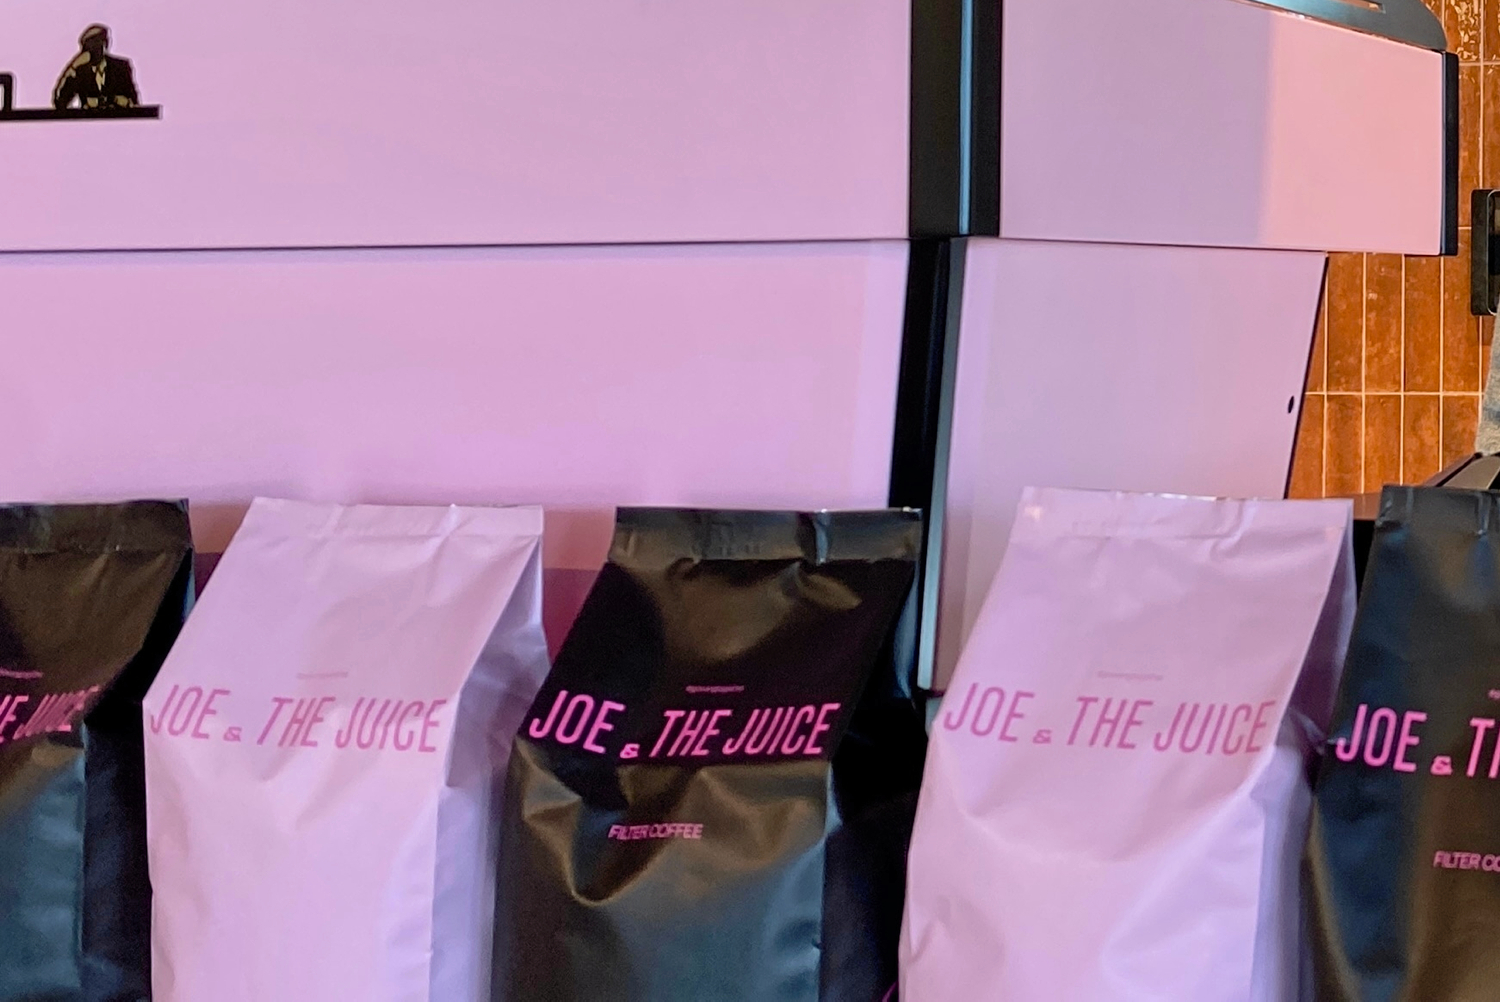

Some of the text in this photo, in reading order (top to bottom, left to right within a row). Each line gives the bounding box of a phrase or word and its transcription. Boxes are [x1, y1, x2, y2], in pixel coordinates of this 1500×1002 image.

[150, 684, 448, 754] JOE & THE JUICE
[528, 690, 841, 760] JOE & THE JUICE
[942, 681, 1277, 757] JOE & THE JUICE
[1335, 704, 1428, 773] JOE
[1430, 755, 1453, 776] &
[608, 823, 704, 840] FILTER COFFEE
[1433, 850, 1482, 870] FILTER
